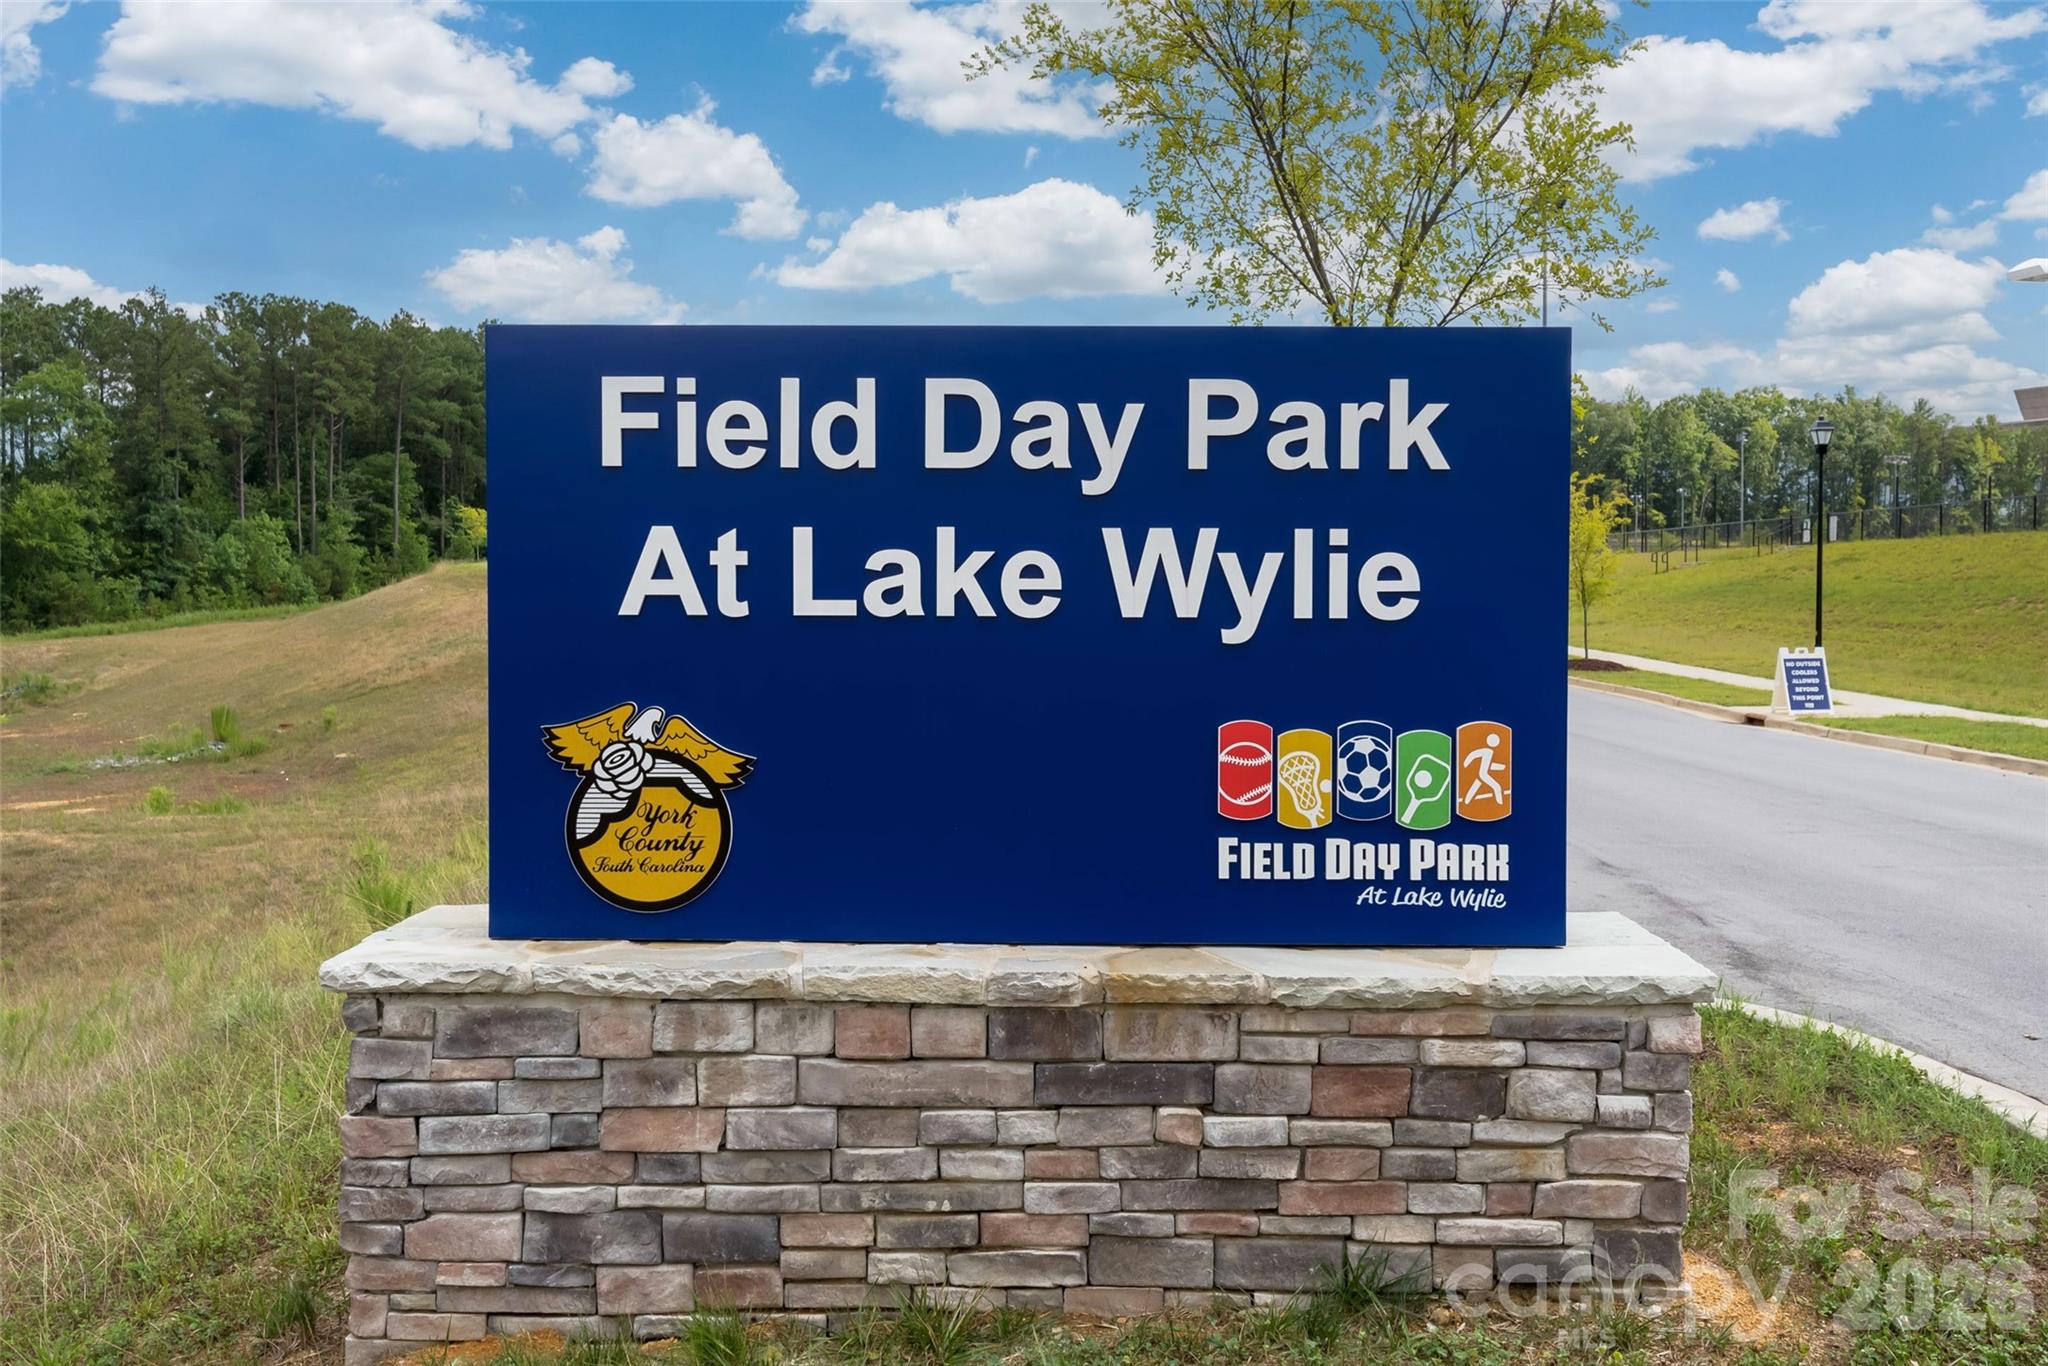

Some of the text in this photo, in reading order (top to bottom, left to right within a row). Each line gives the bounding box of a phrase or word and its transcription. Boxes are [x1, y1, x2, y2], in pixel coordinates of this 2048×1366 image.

[601, 376, 1451, 495] Field Day Park
[618, 526, 1421, 644] At Lake Wylie
[637, 800, 698, 836] York
[615, 826, 707, 862] County
[1218, 837, 1510, 882] FIELD DAY PARK
[592, 856, 705, 875] South Carolina
[1356, 886, 1507, 912] At Lake Wylie
